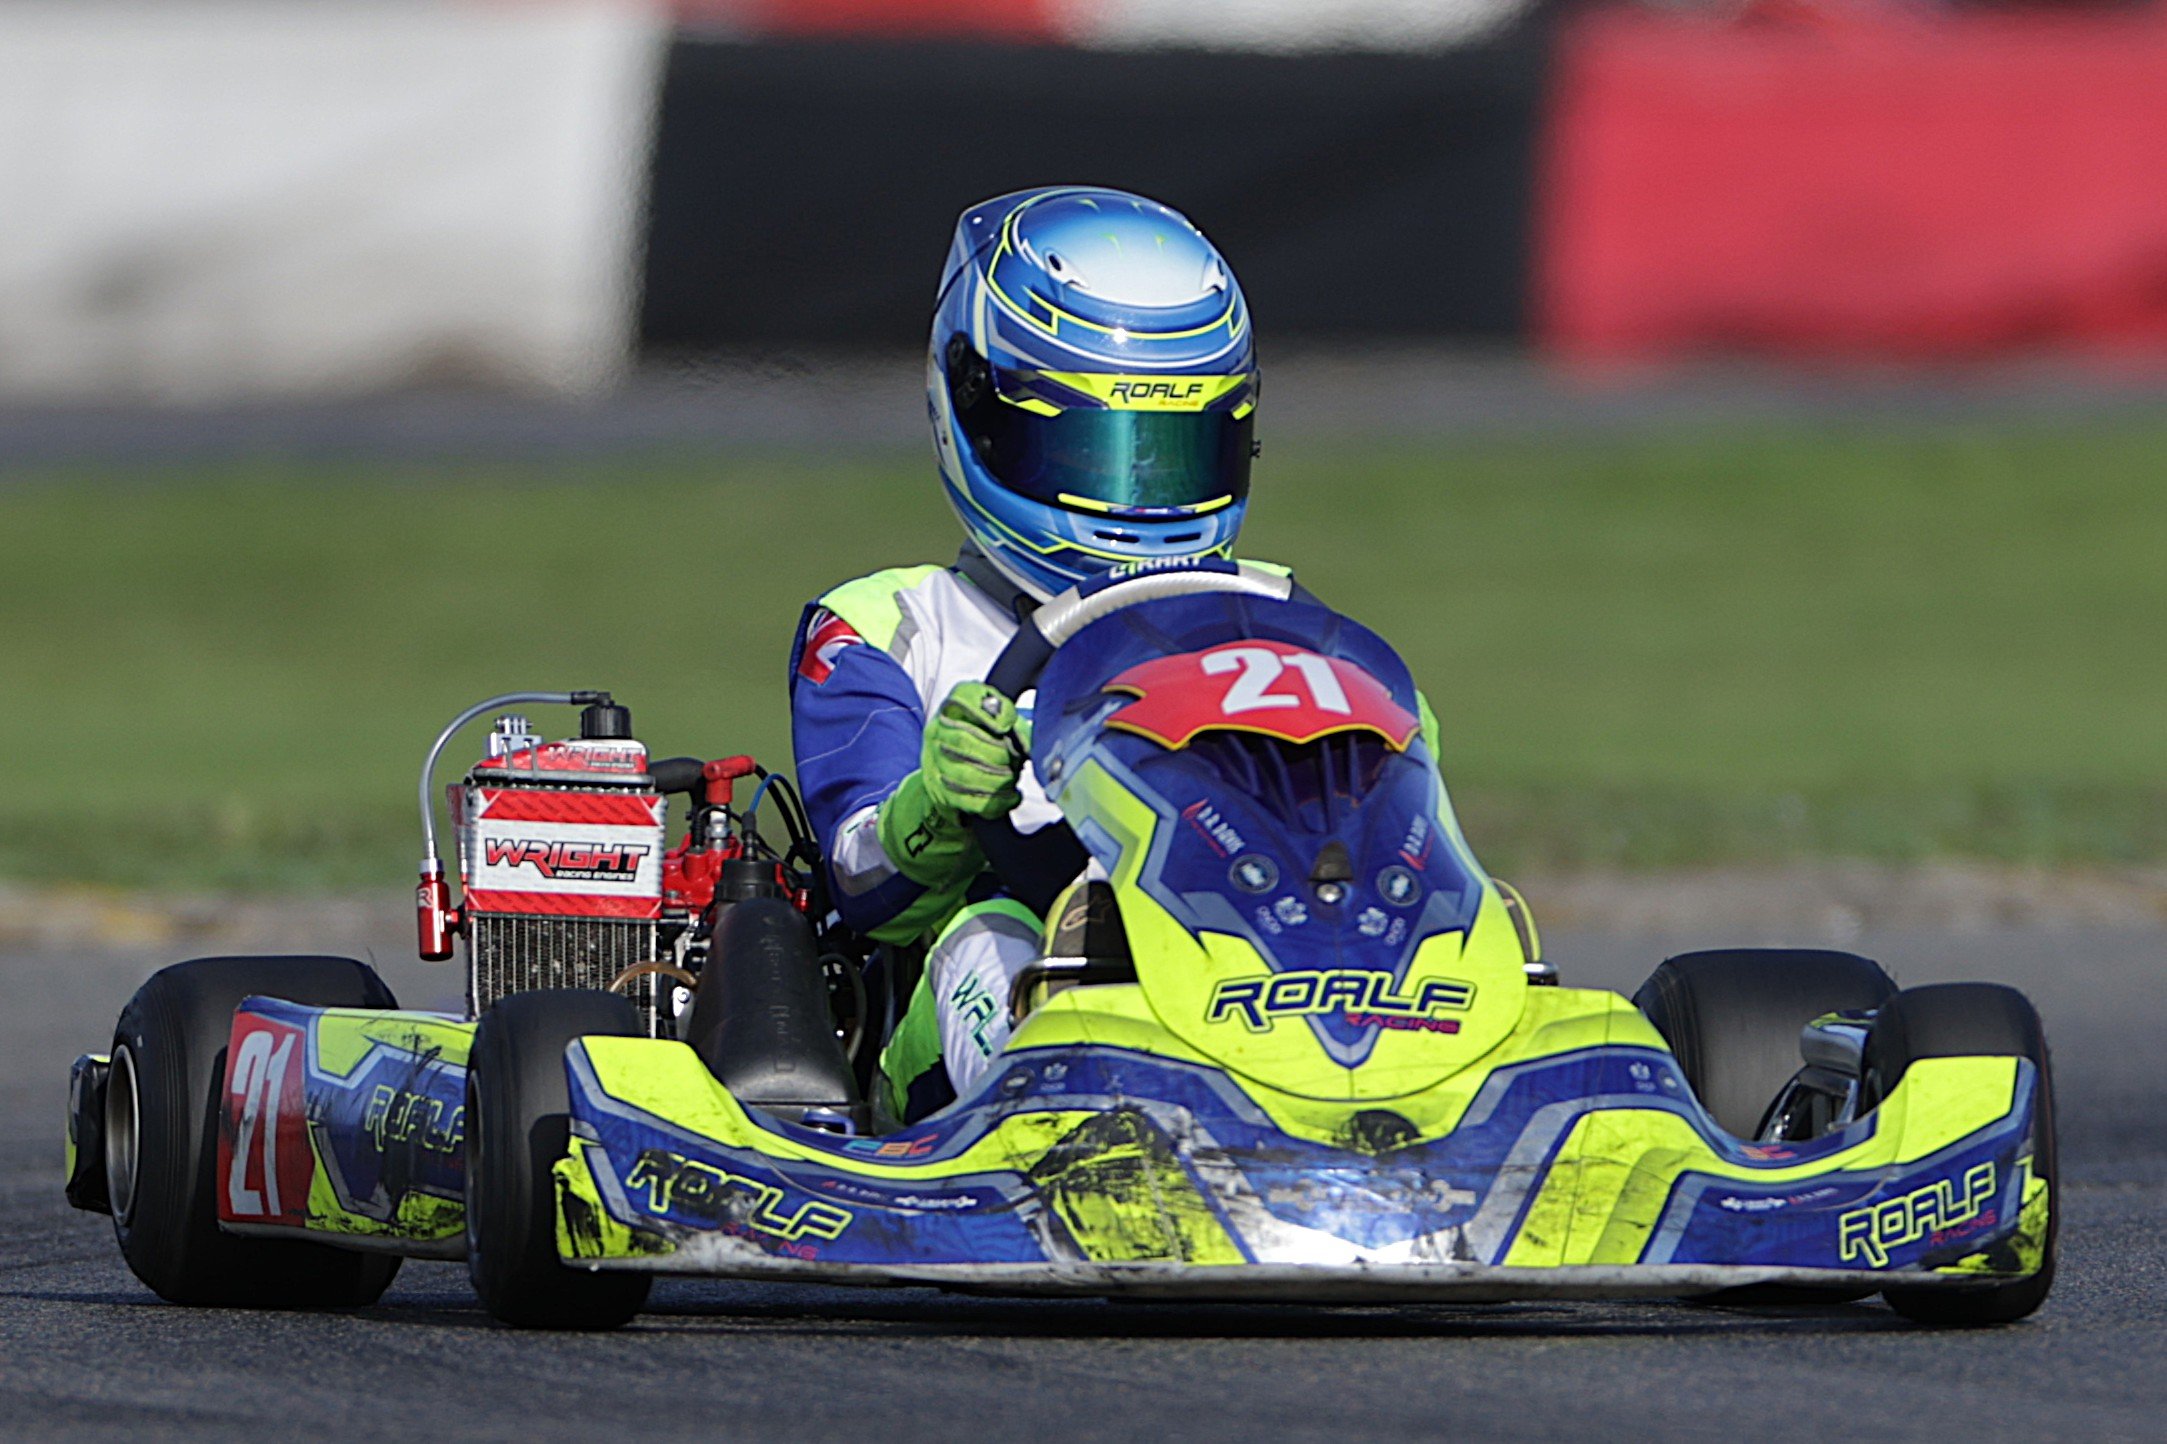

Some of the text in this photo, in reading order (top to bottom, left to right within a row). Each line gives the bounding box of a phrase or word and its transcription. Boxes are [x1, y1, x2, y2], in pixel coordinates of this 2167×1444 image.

[1110, 382, 1204, 404] ROALF
[1201, 647, 1352, 716] 21
[484, 838, 652, 878] WRIGHT
[1205, 969, 1478, 1034] ROALF
[1345, 1012, 1462, 1034] RACING
[228, 1030, 296, 1216] 21
[1838, 1160, 1997, 1269] ROALF
